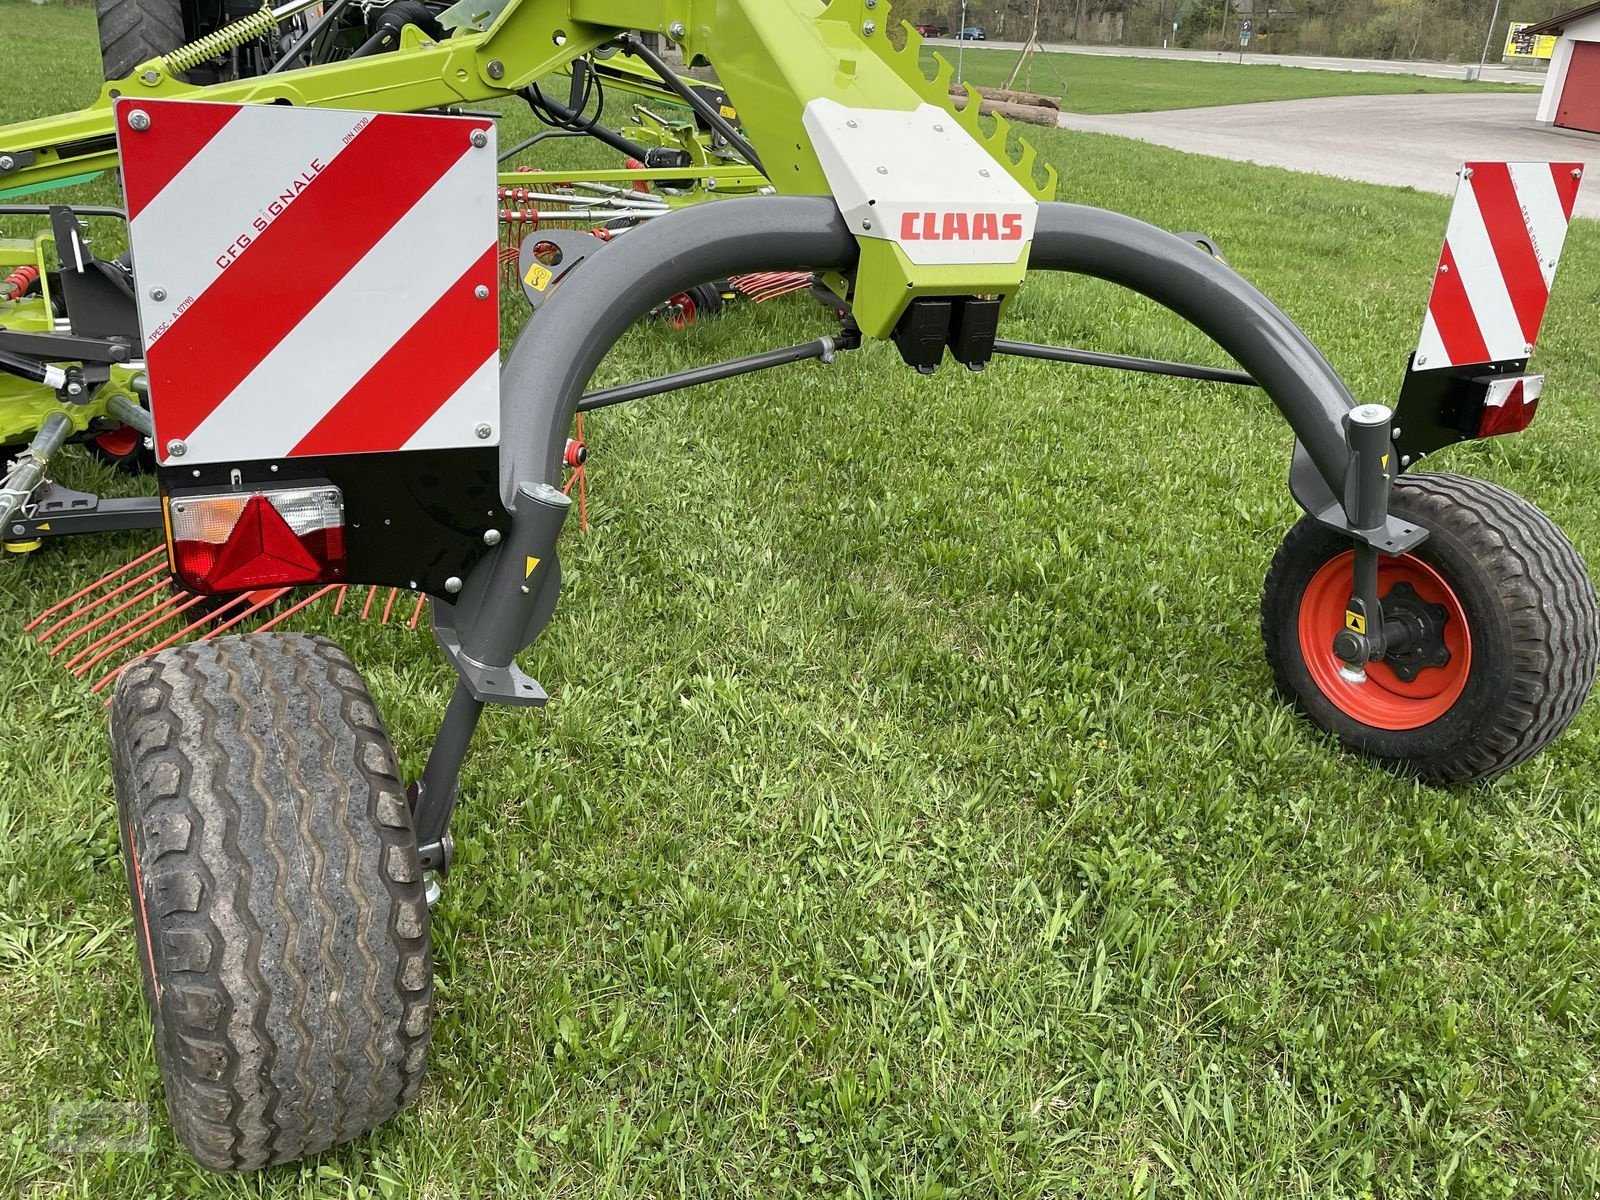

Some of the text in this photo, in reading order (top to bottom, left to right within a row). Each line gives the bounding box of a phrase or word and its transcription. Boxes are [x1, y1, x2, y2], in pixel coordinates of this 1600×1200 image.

[342, 117, 369, 144] DIN 11030
[900, 212, 1023, 240] CLAAS
[216, 233, 252, 269] CFG
[148, 321, 170, 342] TPESC
[176, 295, 195, 313] 07190
